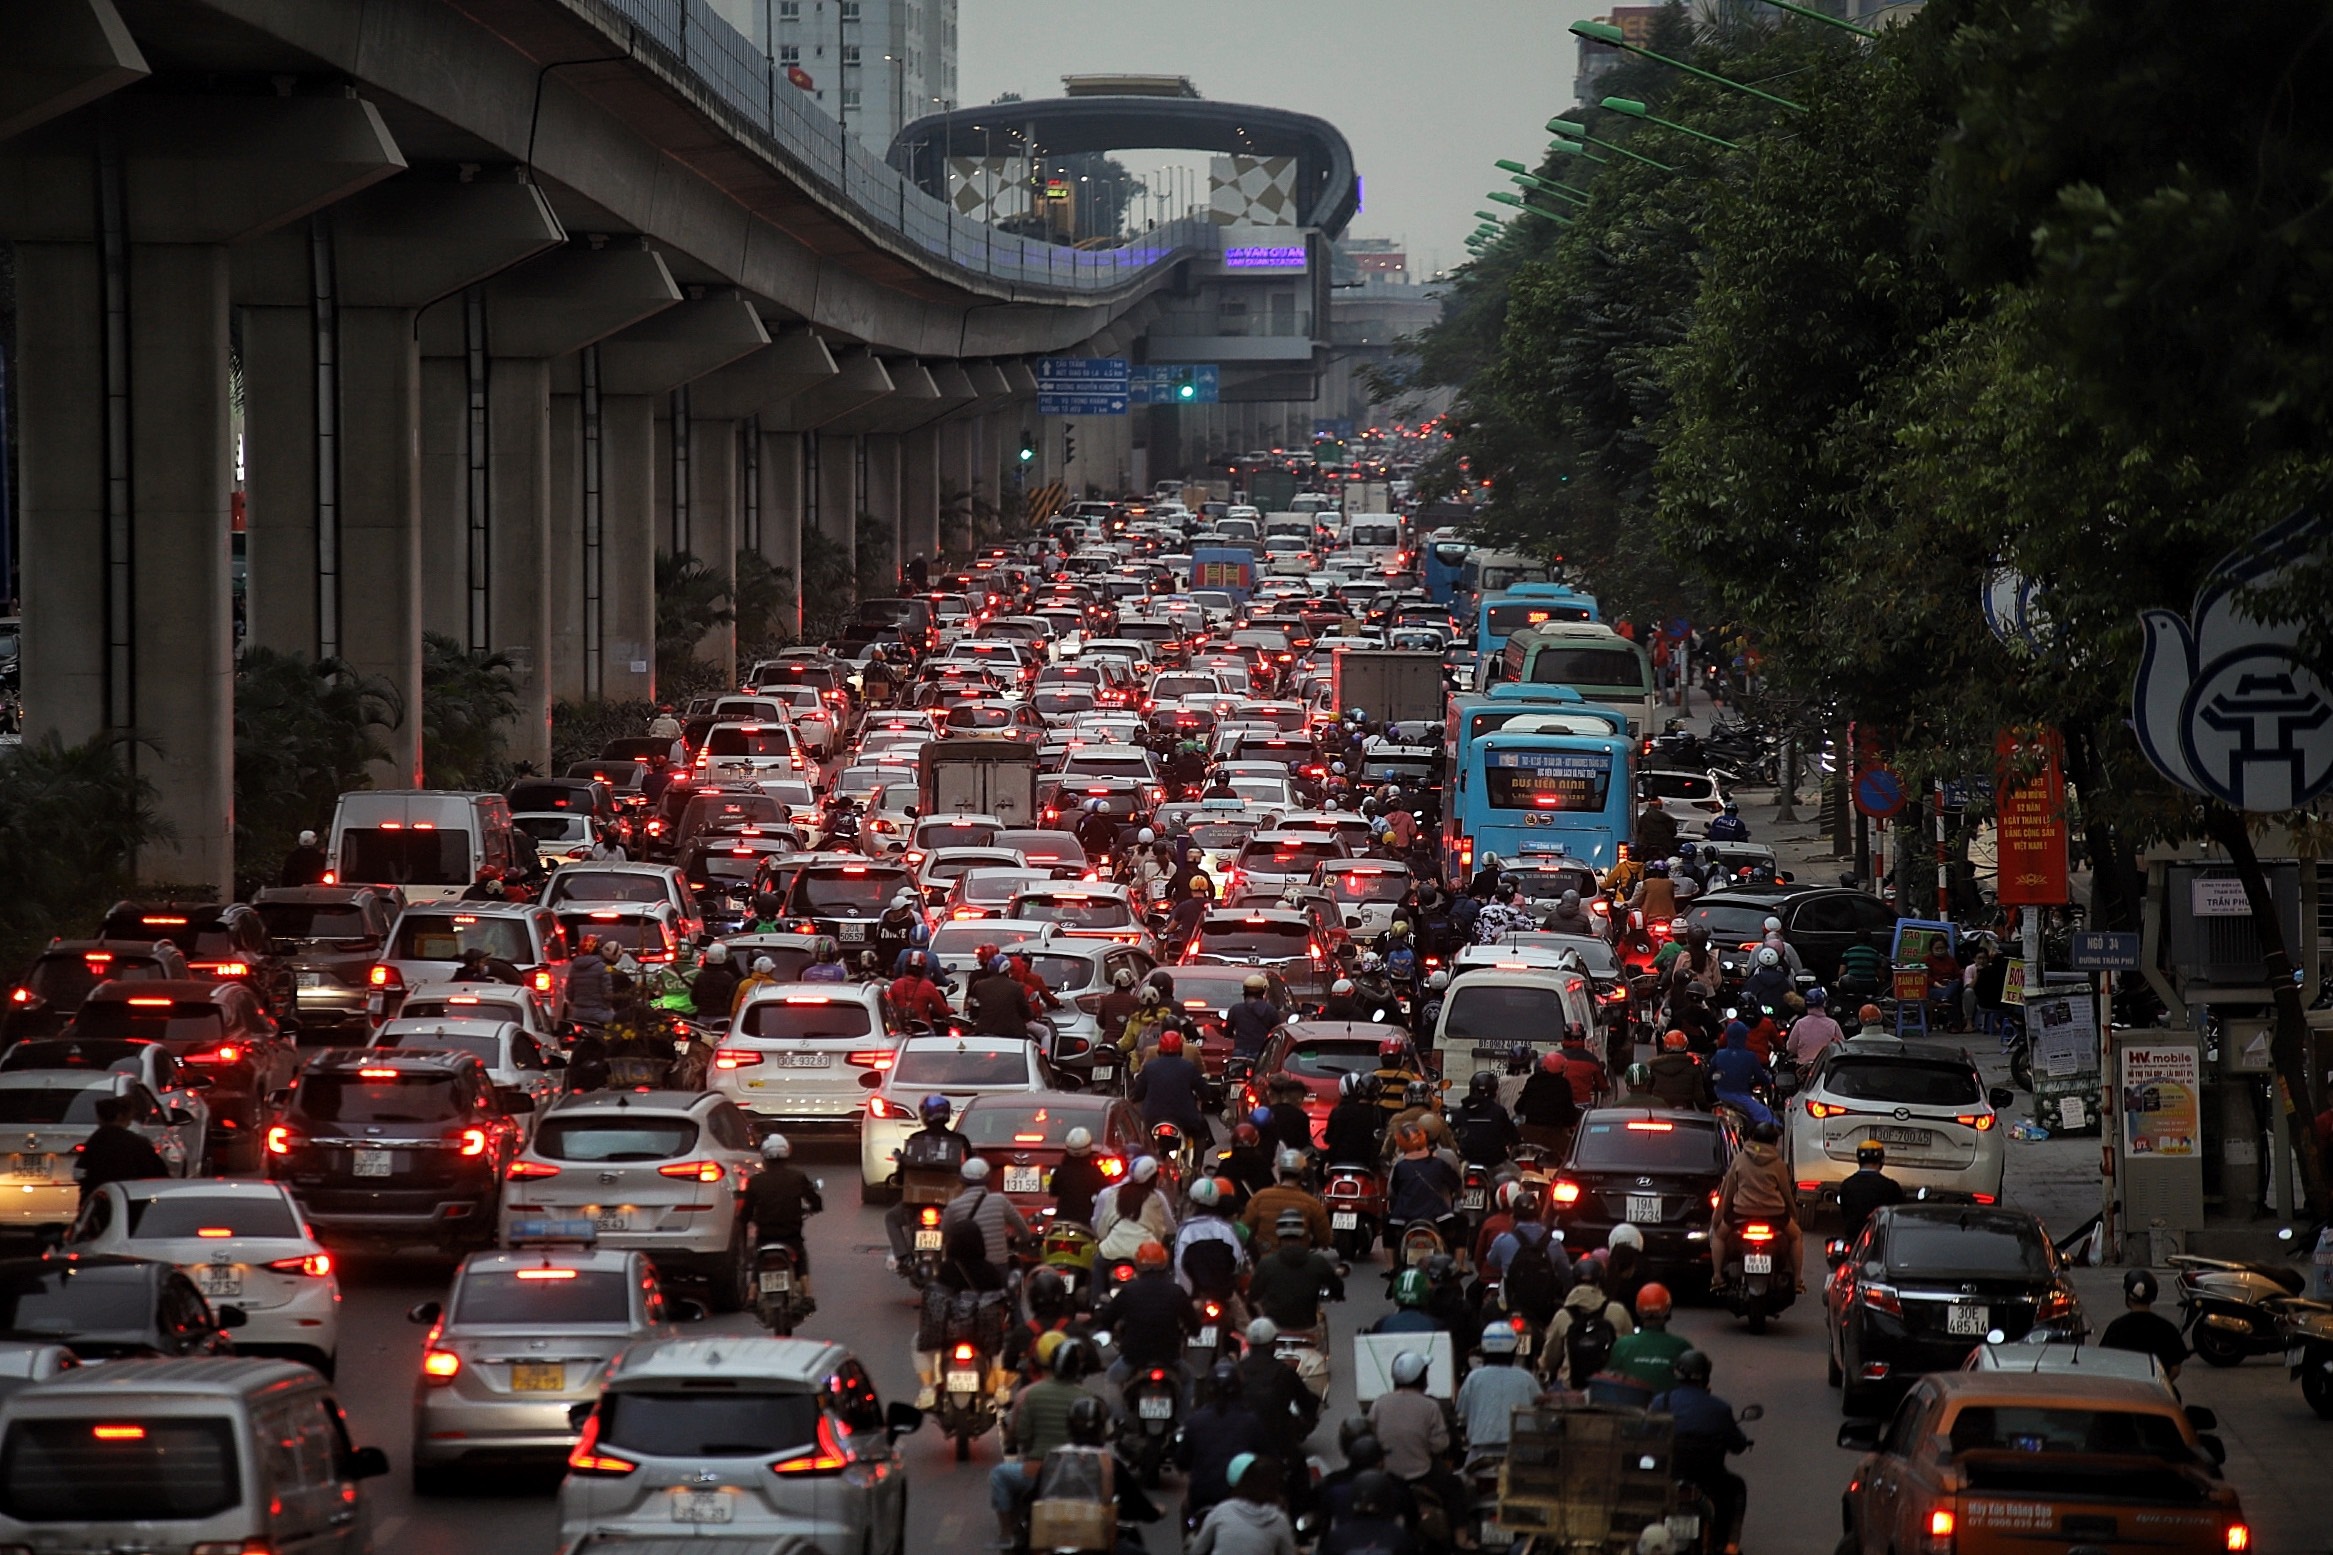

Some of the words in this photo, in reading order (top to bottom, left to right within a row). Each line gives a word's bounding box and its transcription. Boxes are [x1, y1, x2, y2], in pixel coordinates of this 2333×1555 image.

[1511, 778, 1531, 788] BUS
[2153, 1053, 2192, 1064] mobile
[1012, 1168, 1029, 1179] 30F
[1636, 1198, 1653, 1209] 19A
[1958, 1306, 1978, 1319] 30E
[1949, 1320, 1987, 1333] 485.14
[1968, 1502, 1987, 1517] Máy
